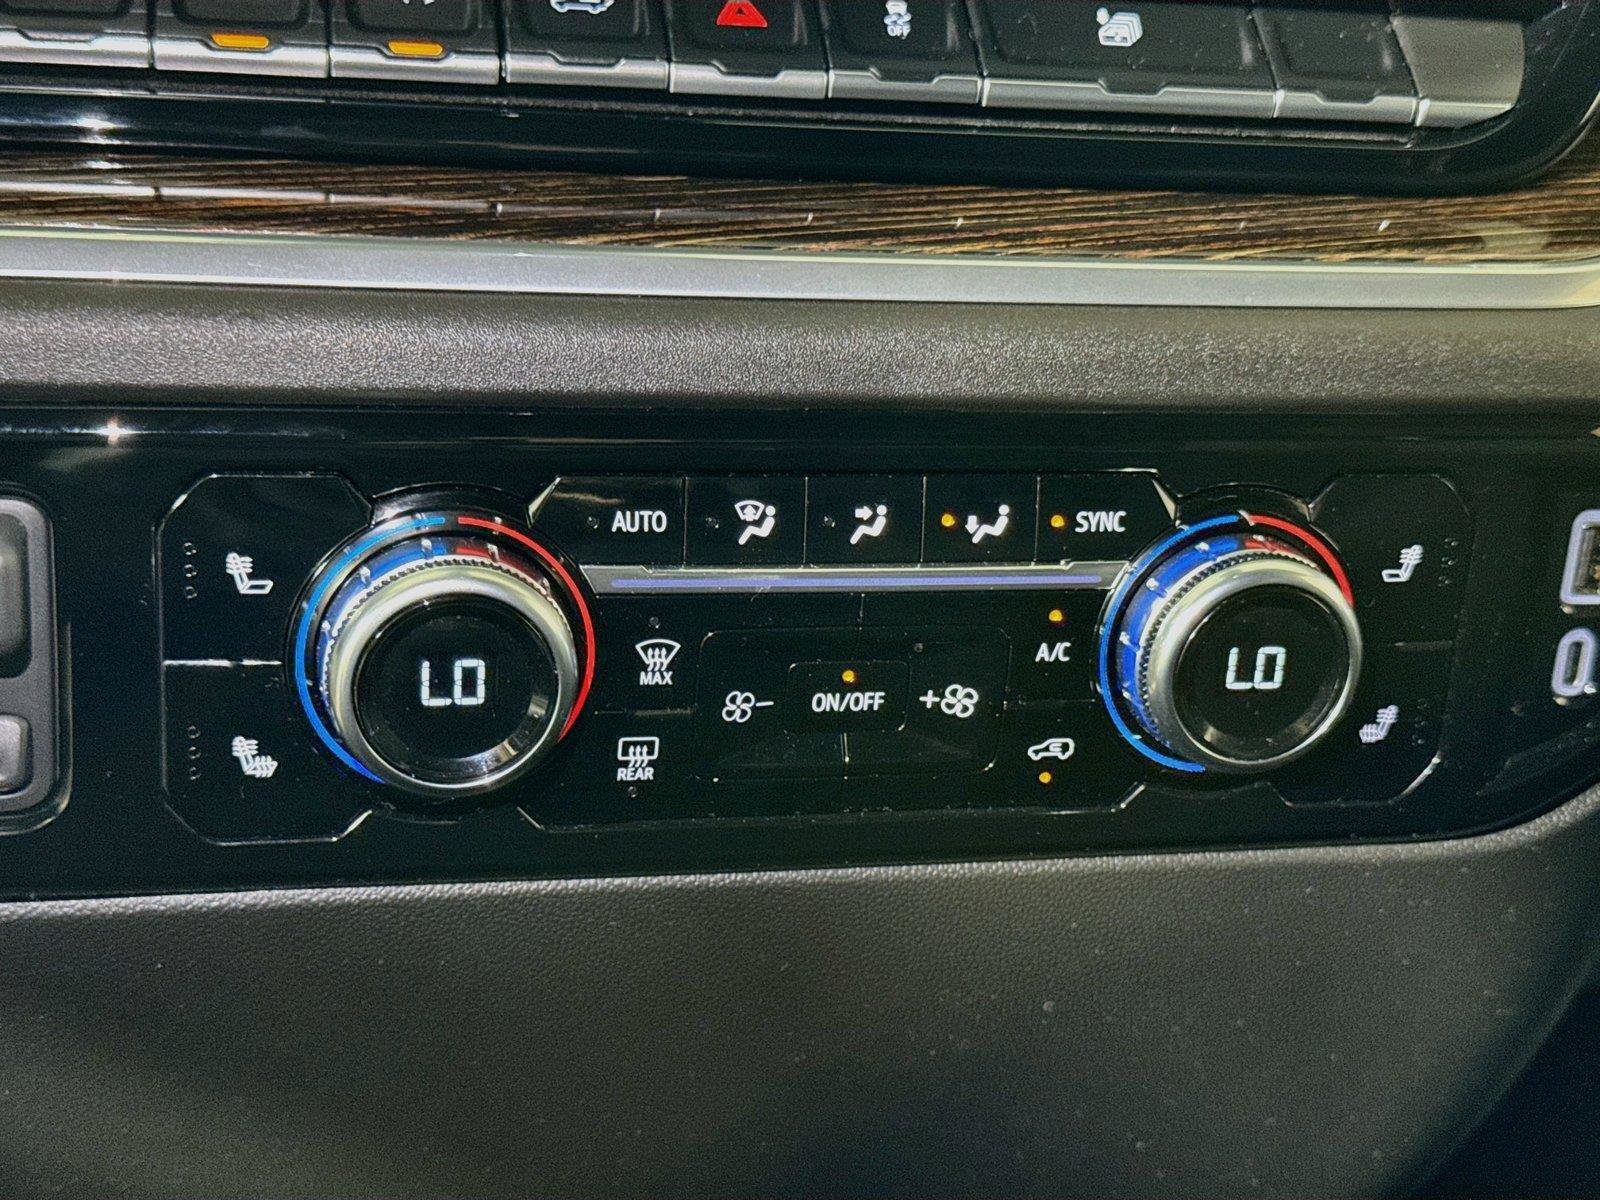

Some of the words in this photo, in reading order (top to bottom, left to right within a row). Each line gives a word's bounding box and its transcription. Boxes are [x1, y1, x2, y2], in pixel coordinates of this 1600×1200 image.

[611, 509, 667, 533] AUTO
[1075, 510, 1127, 533] SYNC
[1035, 641, 1071, 663] A/C
[639, 671, 673, 686] MAX
[1225, 646, 1287, 691] LO
[421, 658, 486, 707] LO
[811, 691, 886, 713] ON/OFF
[616, 767, 654, 782] REAR
